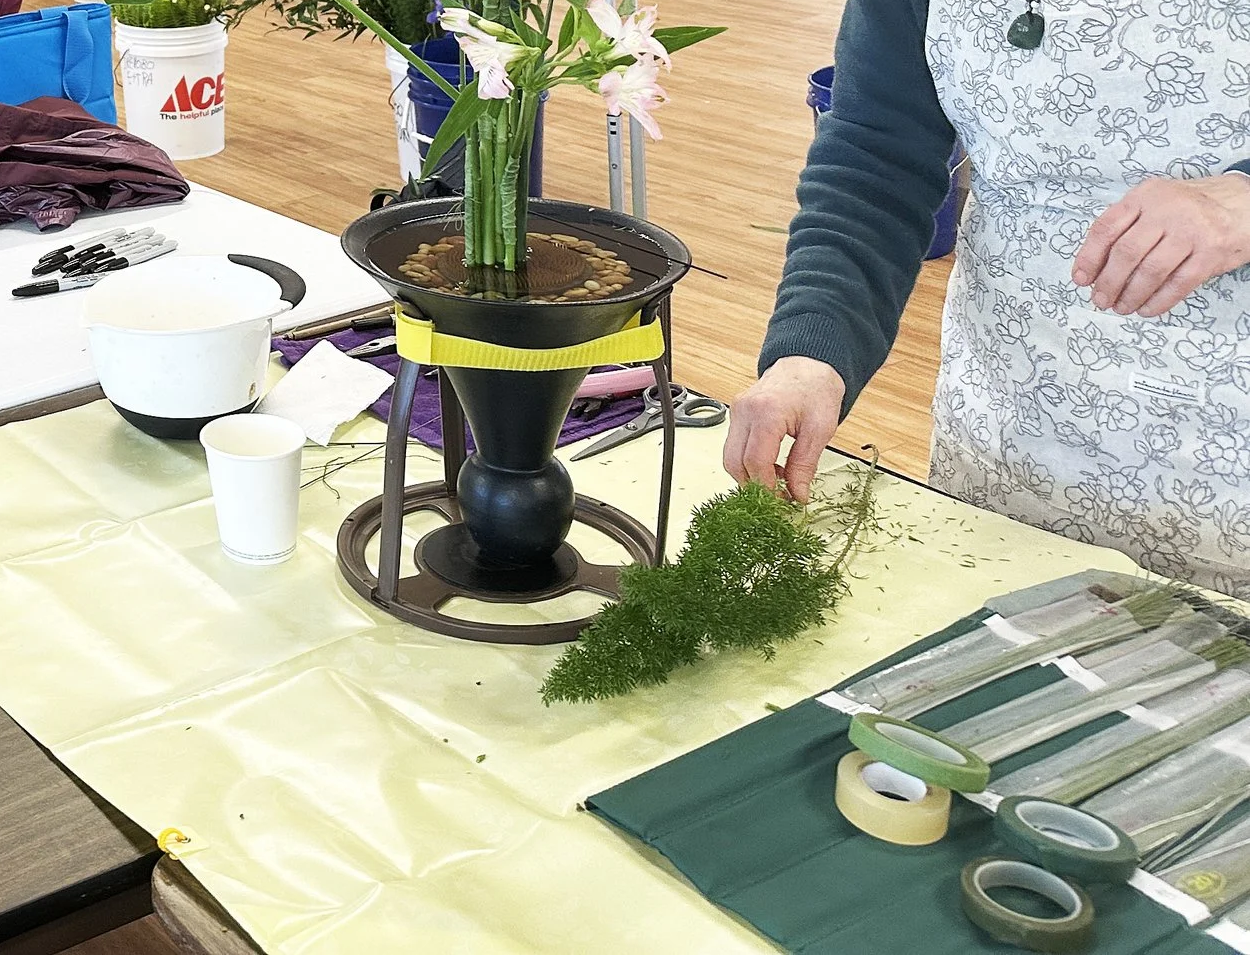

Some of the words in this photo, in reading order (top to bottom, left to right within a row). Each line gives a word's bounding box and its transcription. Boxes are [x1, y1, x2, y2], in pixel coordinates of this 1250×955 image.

[160, 72, 225, 113] ACE
[160, 113, 178, 121] The
[179, 110, 210, 121] helpful
[210, 105, 224, 116] plac
